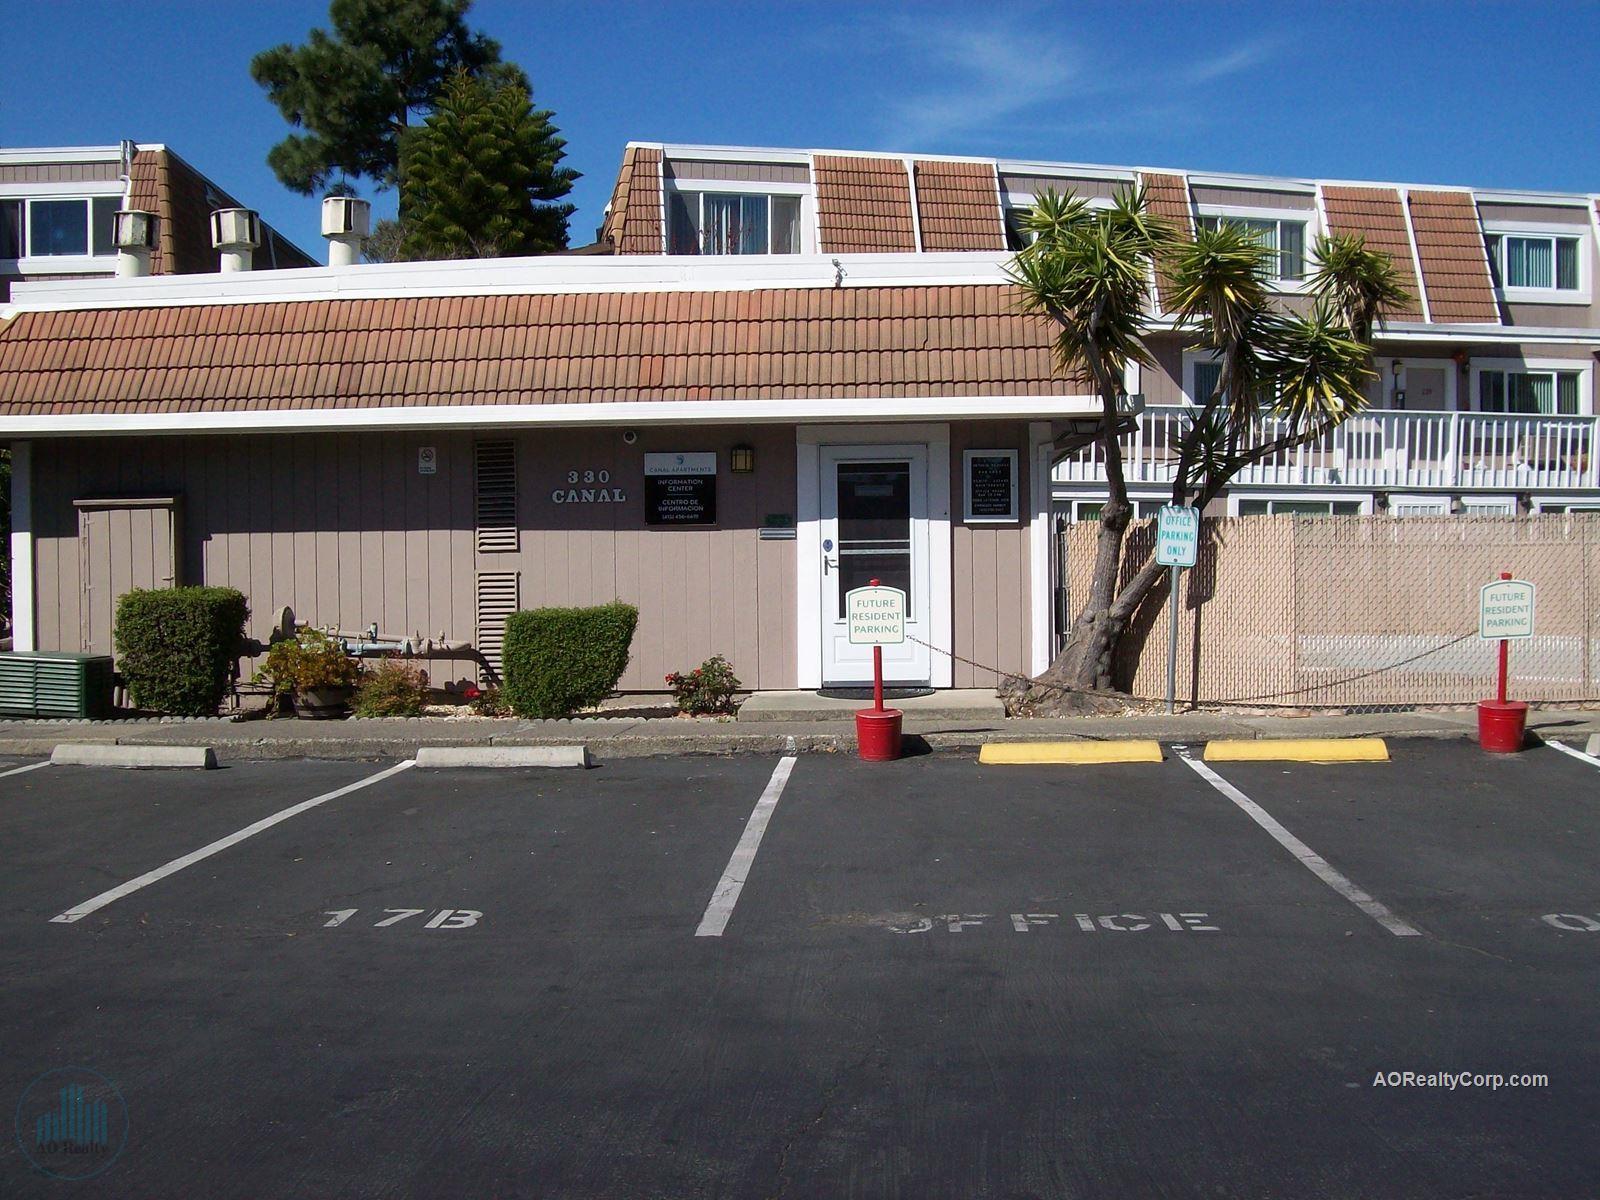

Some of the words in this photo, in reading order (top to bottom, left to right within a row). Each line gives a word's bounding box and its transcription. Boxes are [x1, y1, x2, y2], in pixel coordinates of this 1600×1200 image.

[567, 470, 610, 484] 330
[552, 488, 626, 504] CANAL
[1165, 516, 1192, 527] OFFICE
[1161, 530, 1194, 542] PARKING
[1167, 546, 1187, 556] ONLY
[1490, 592, 1526, 601] FUTURE
[857, 599, 896, 608] FUTURE
[1484, 604, 1529, 614] RESIDENT
[852, 612, 901, 621] RESIDENT
[1487, 617, 1528, 628] PARKING
[854, 625, 899, 633] PARKING
